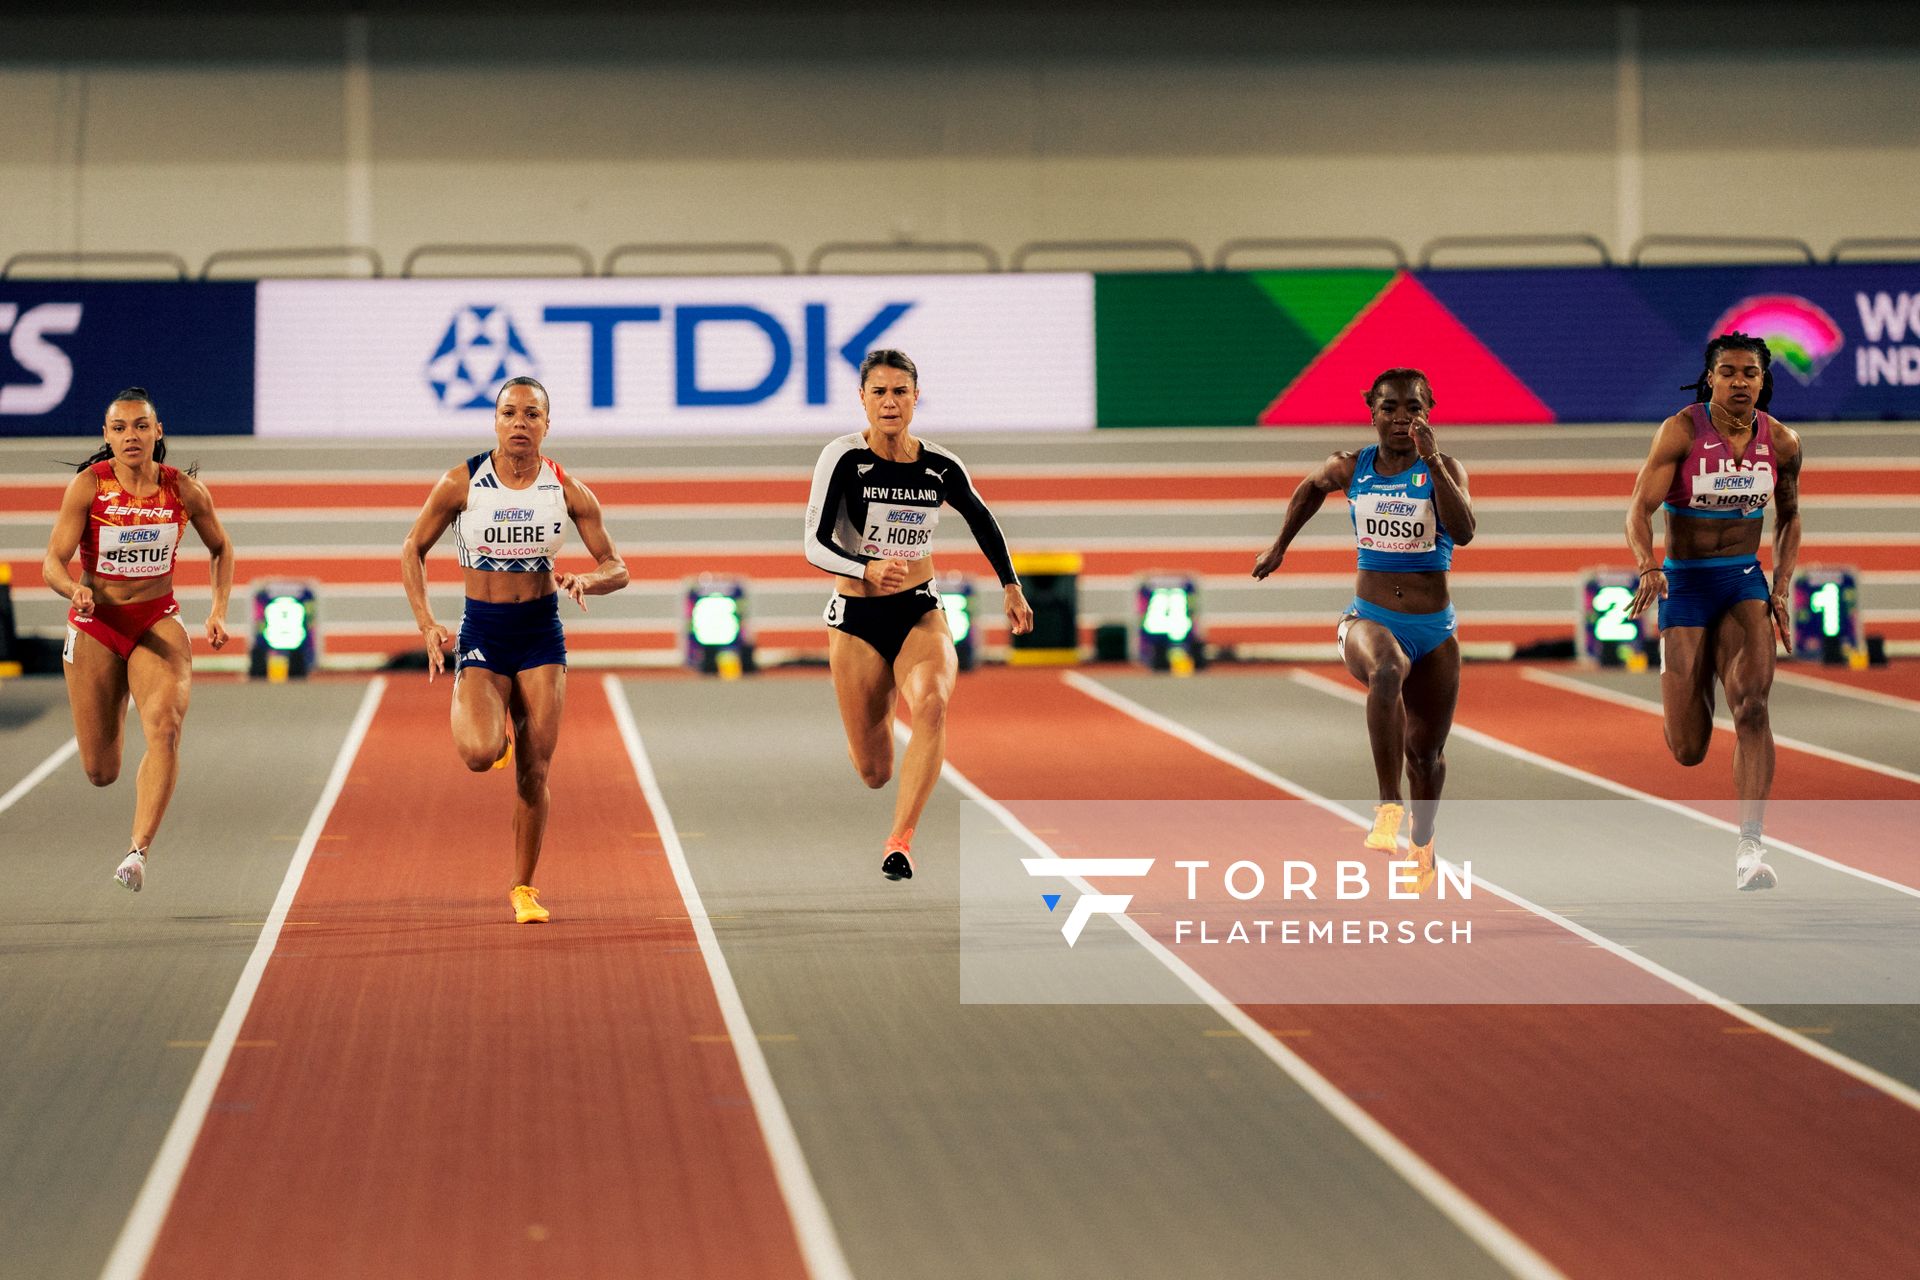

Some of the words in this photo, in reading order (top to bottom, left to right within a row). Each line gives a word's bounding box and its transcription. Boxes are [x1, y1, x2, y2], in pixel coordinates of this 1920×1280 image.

[543, 302, 914, 407] TDK
[862, 486, 889, 499] NEW
[891, 488, 937, 501] ZEALAND
[104, 505, 173, 518] ESPAÑA
[484, 526, 545, 543] OLIERE
[868, 525, 882, 542] Z.
[886, 527, 931, 545] HOBBS
[1366, 518, 1425, 538] DOSSO
[106, 545, 169, 563] BESTUÉ
[495, 547, 538, 556] GLASGOW
[1376, 541, 1420, 550] GLASGOW
[118, 565, 161, 574] GLASGOW
[1142, 588, 1193, 643] 4
[1592, 585, 1639, 641] 2
[1810, 583, 1840, 636] 1
